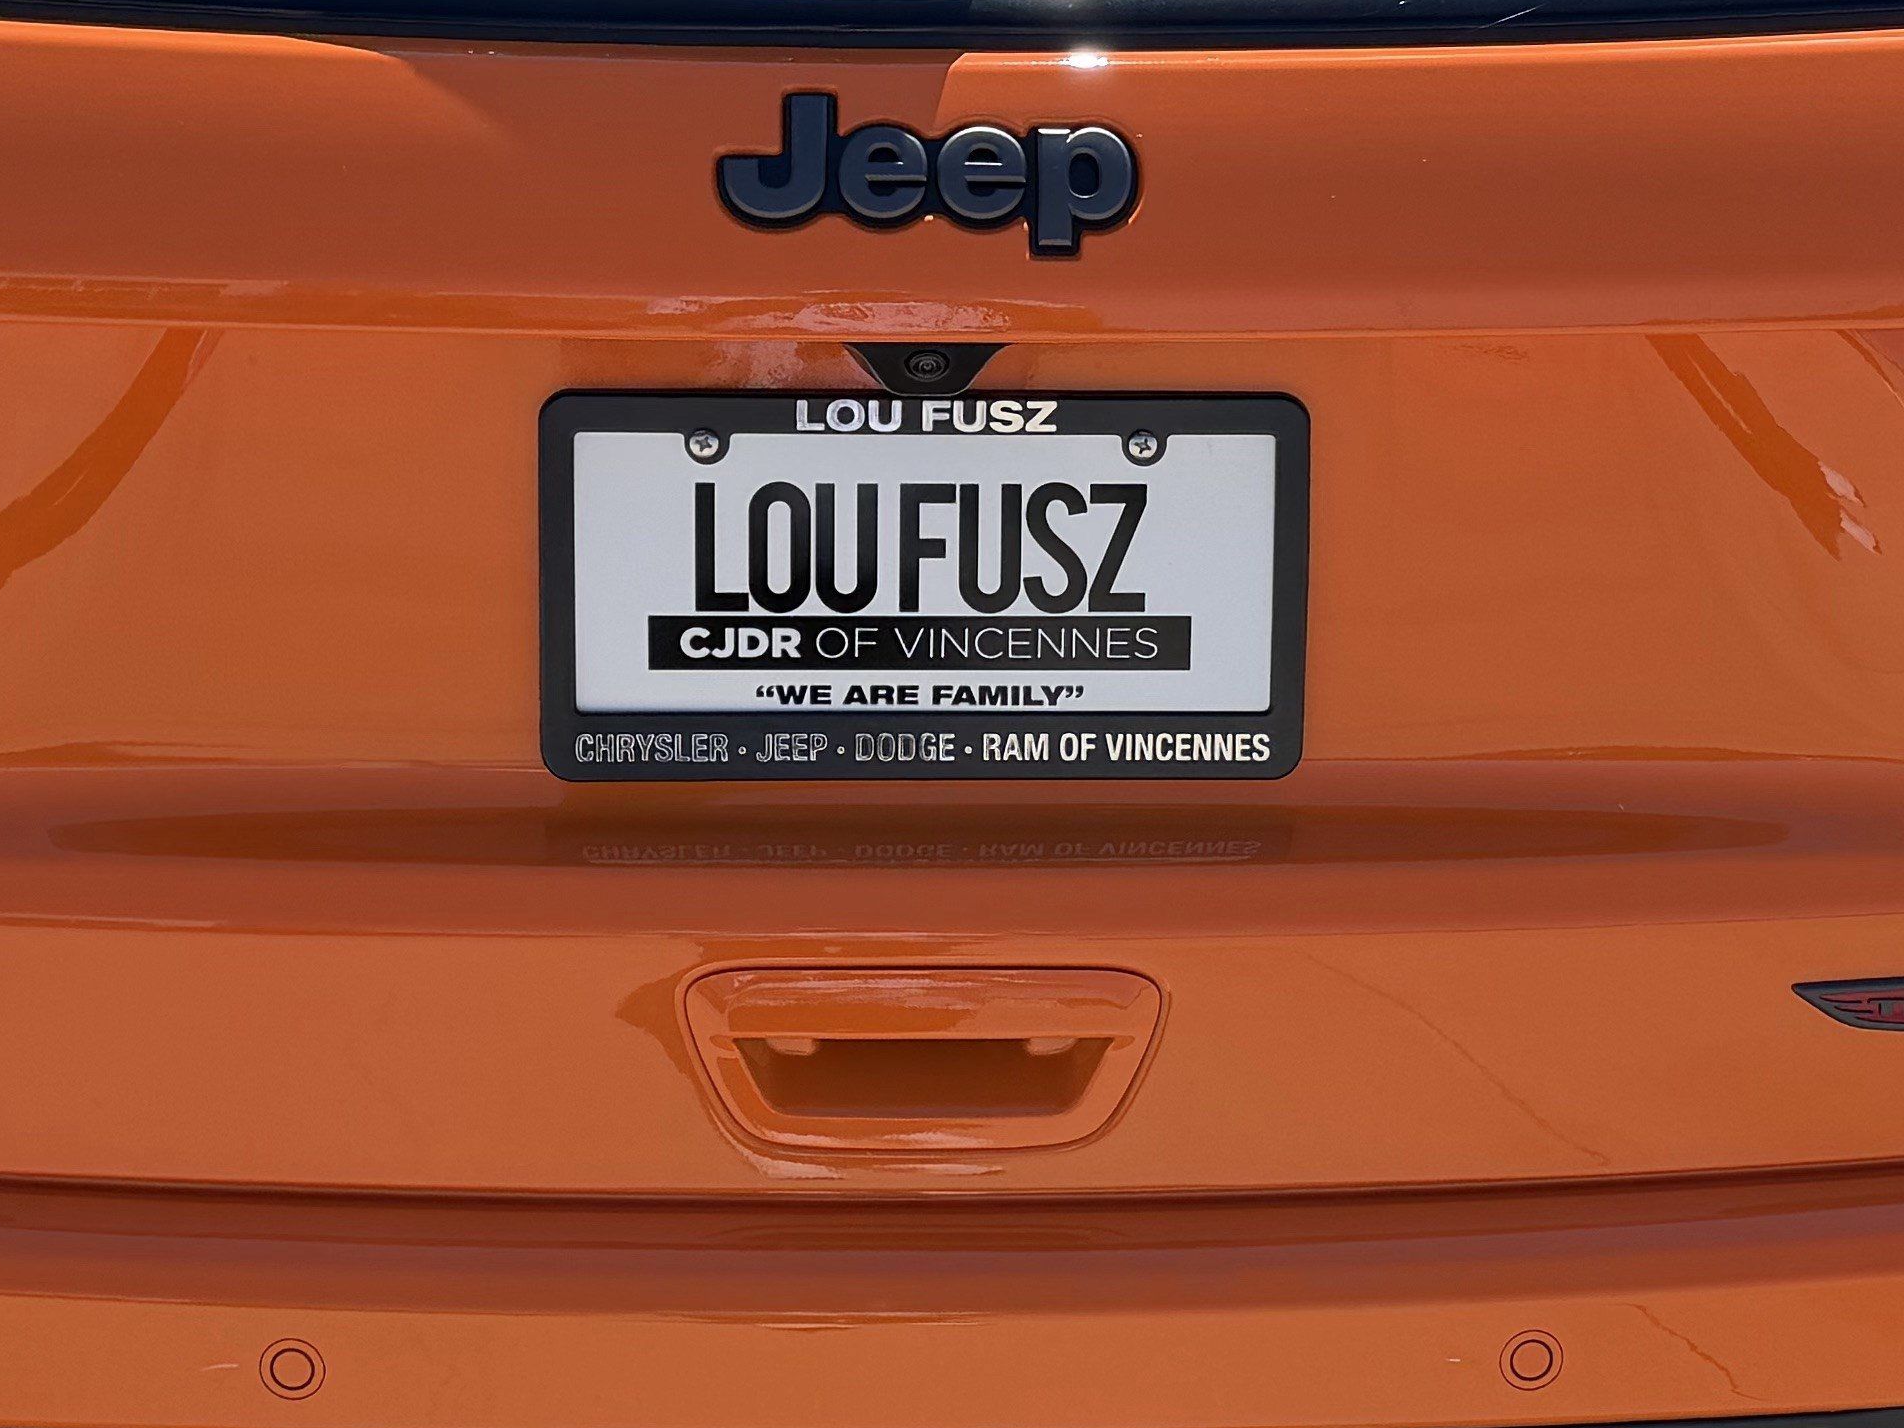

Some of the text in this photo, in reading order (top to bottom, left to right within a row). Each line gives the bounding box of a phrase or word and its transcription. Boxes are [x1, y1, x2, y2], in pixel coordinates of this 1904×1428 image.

[717, 91, 1139, 257] Jeep
[795, 398, 1058, 434] LOU FUSZ
[694, 481, 1148, 613] LOU FUSZ
[679, 626, 1159, 660] CJDR OF VINCENNES
[842, 684, 920, 705] ARE
[574, 732, 1271, 763] CHRYSLER JEEP DODGE RAM OF VINCENNES
